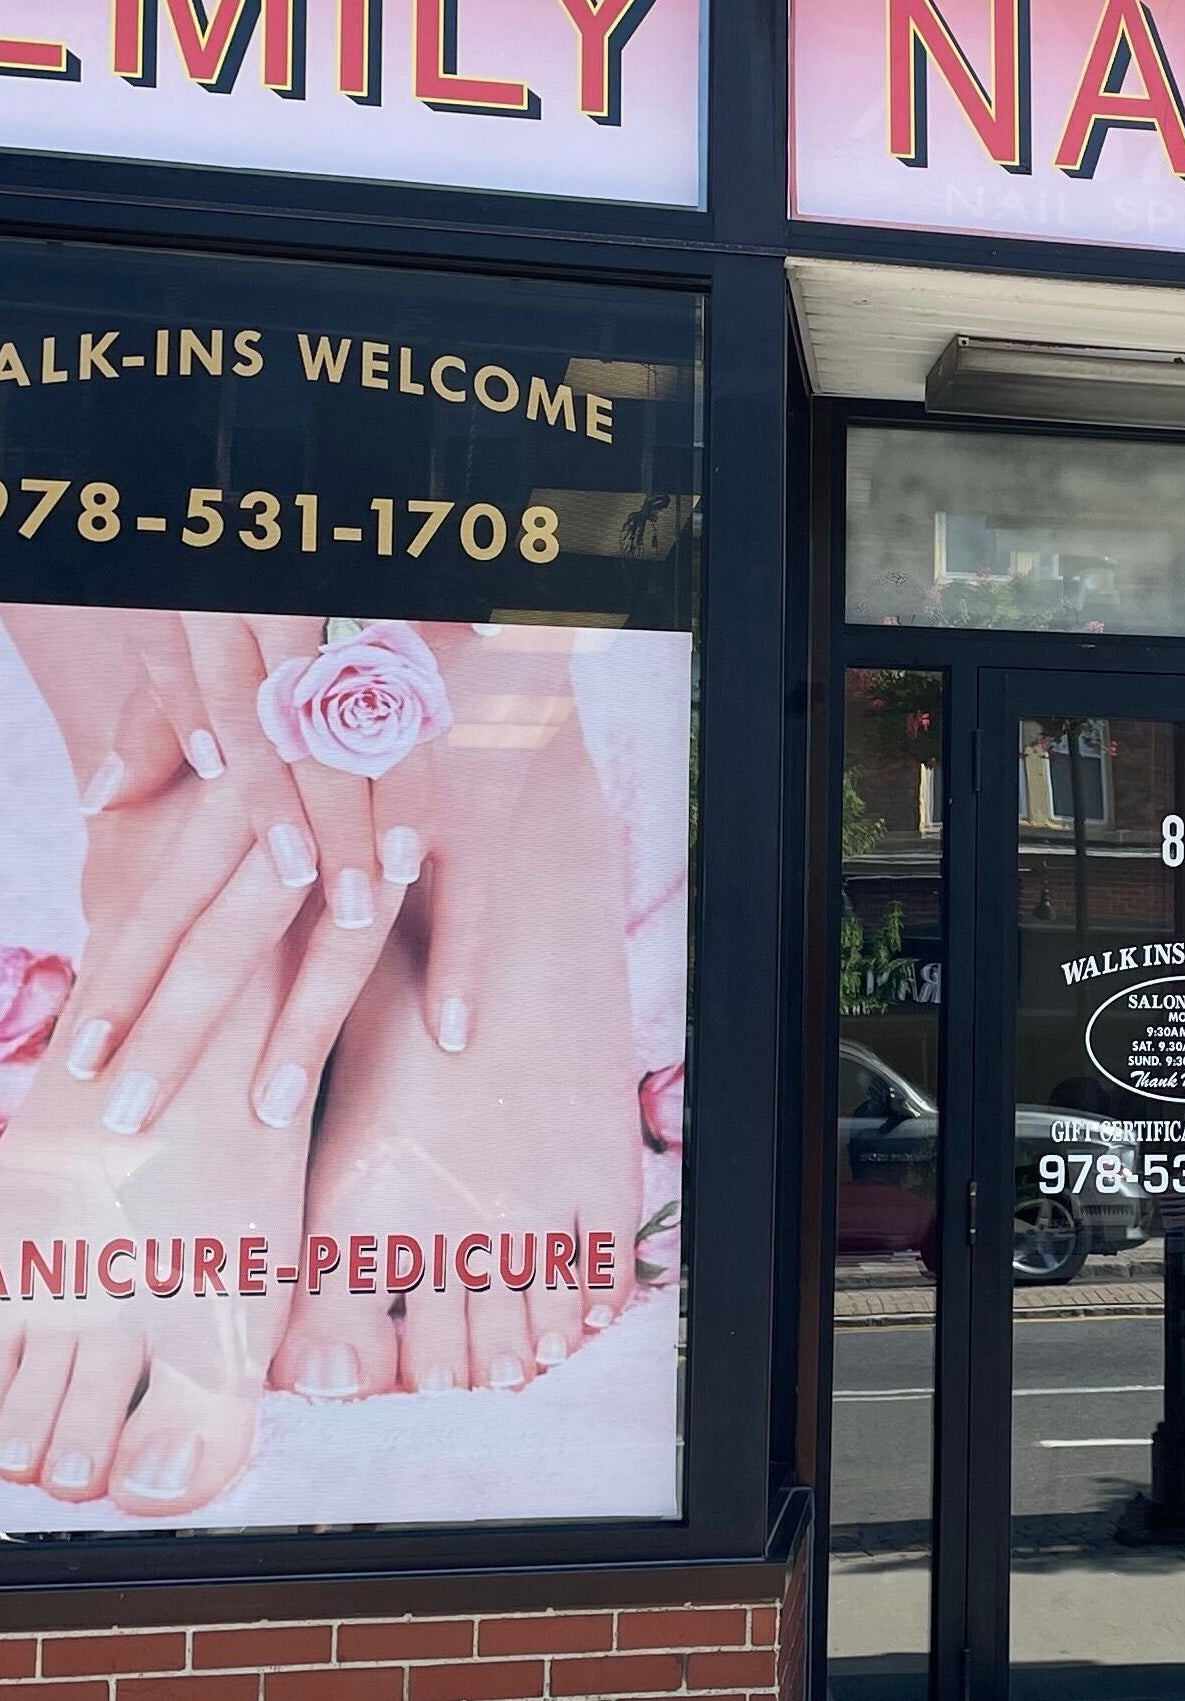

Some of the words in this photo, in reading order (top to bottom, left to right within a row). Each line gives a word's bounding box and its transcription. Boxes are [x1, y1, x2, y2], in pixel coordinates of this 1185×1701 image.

[297, 332, 615, 445] WELCOME
[0, 479, 560, 565] 78-531-1708
[1060, 946, 1139, 986] WALK
[1143, 942, 1185, 967] INS
[1132, 1041, 1155, 1052] SAT.
[1127, 1056, 1163, 1067] SUND.
[1130, 1071, 1179, 1089] Thank
[1051, 1121, 1095, 1143] GIFT
